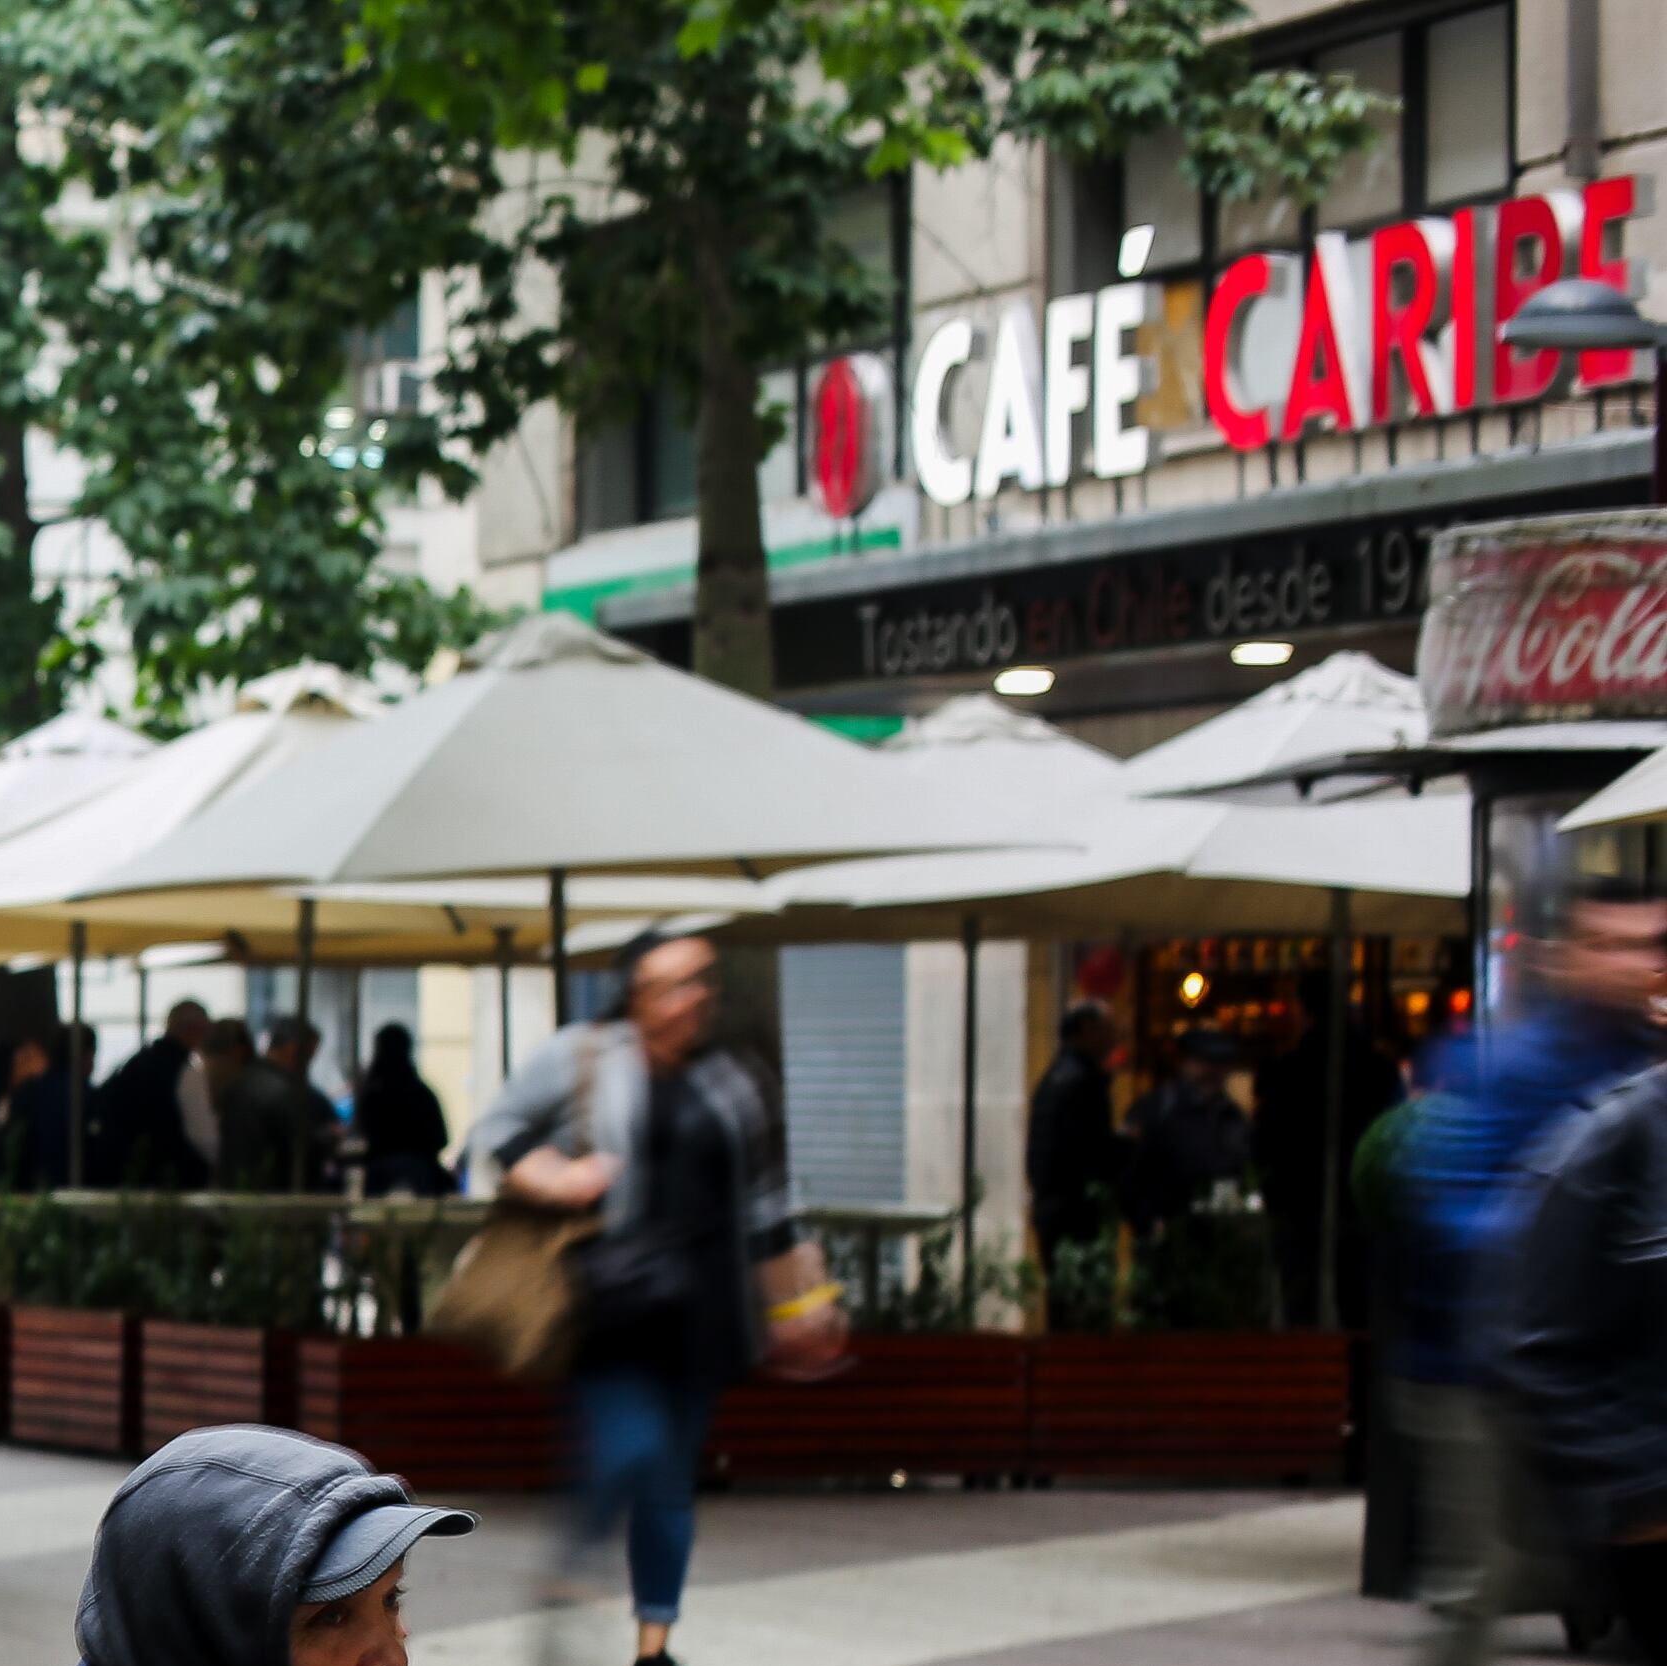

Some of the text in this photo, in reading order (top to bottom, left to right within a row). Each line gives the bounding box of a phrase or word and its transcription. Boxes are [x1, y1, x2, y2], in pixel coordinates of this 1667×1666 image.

[912, 174, 1637, 506] CAFÉ CARIBE
[856, 586, 1020, 677] Tostando
[1204, 541, 1332, 636] desde
